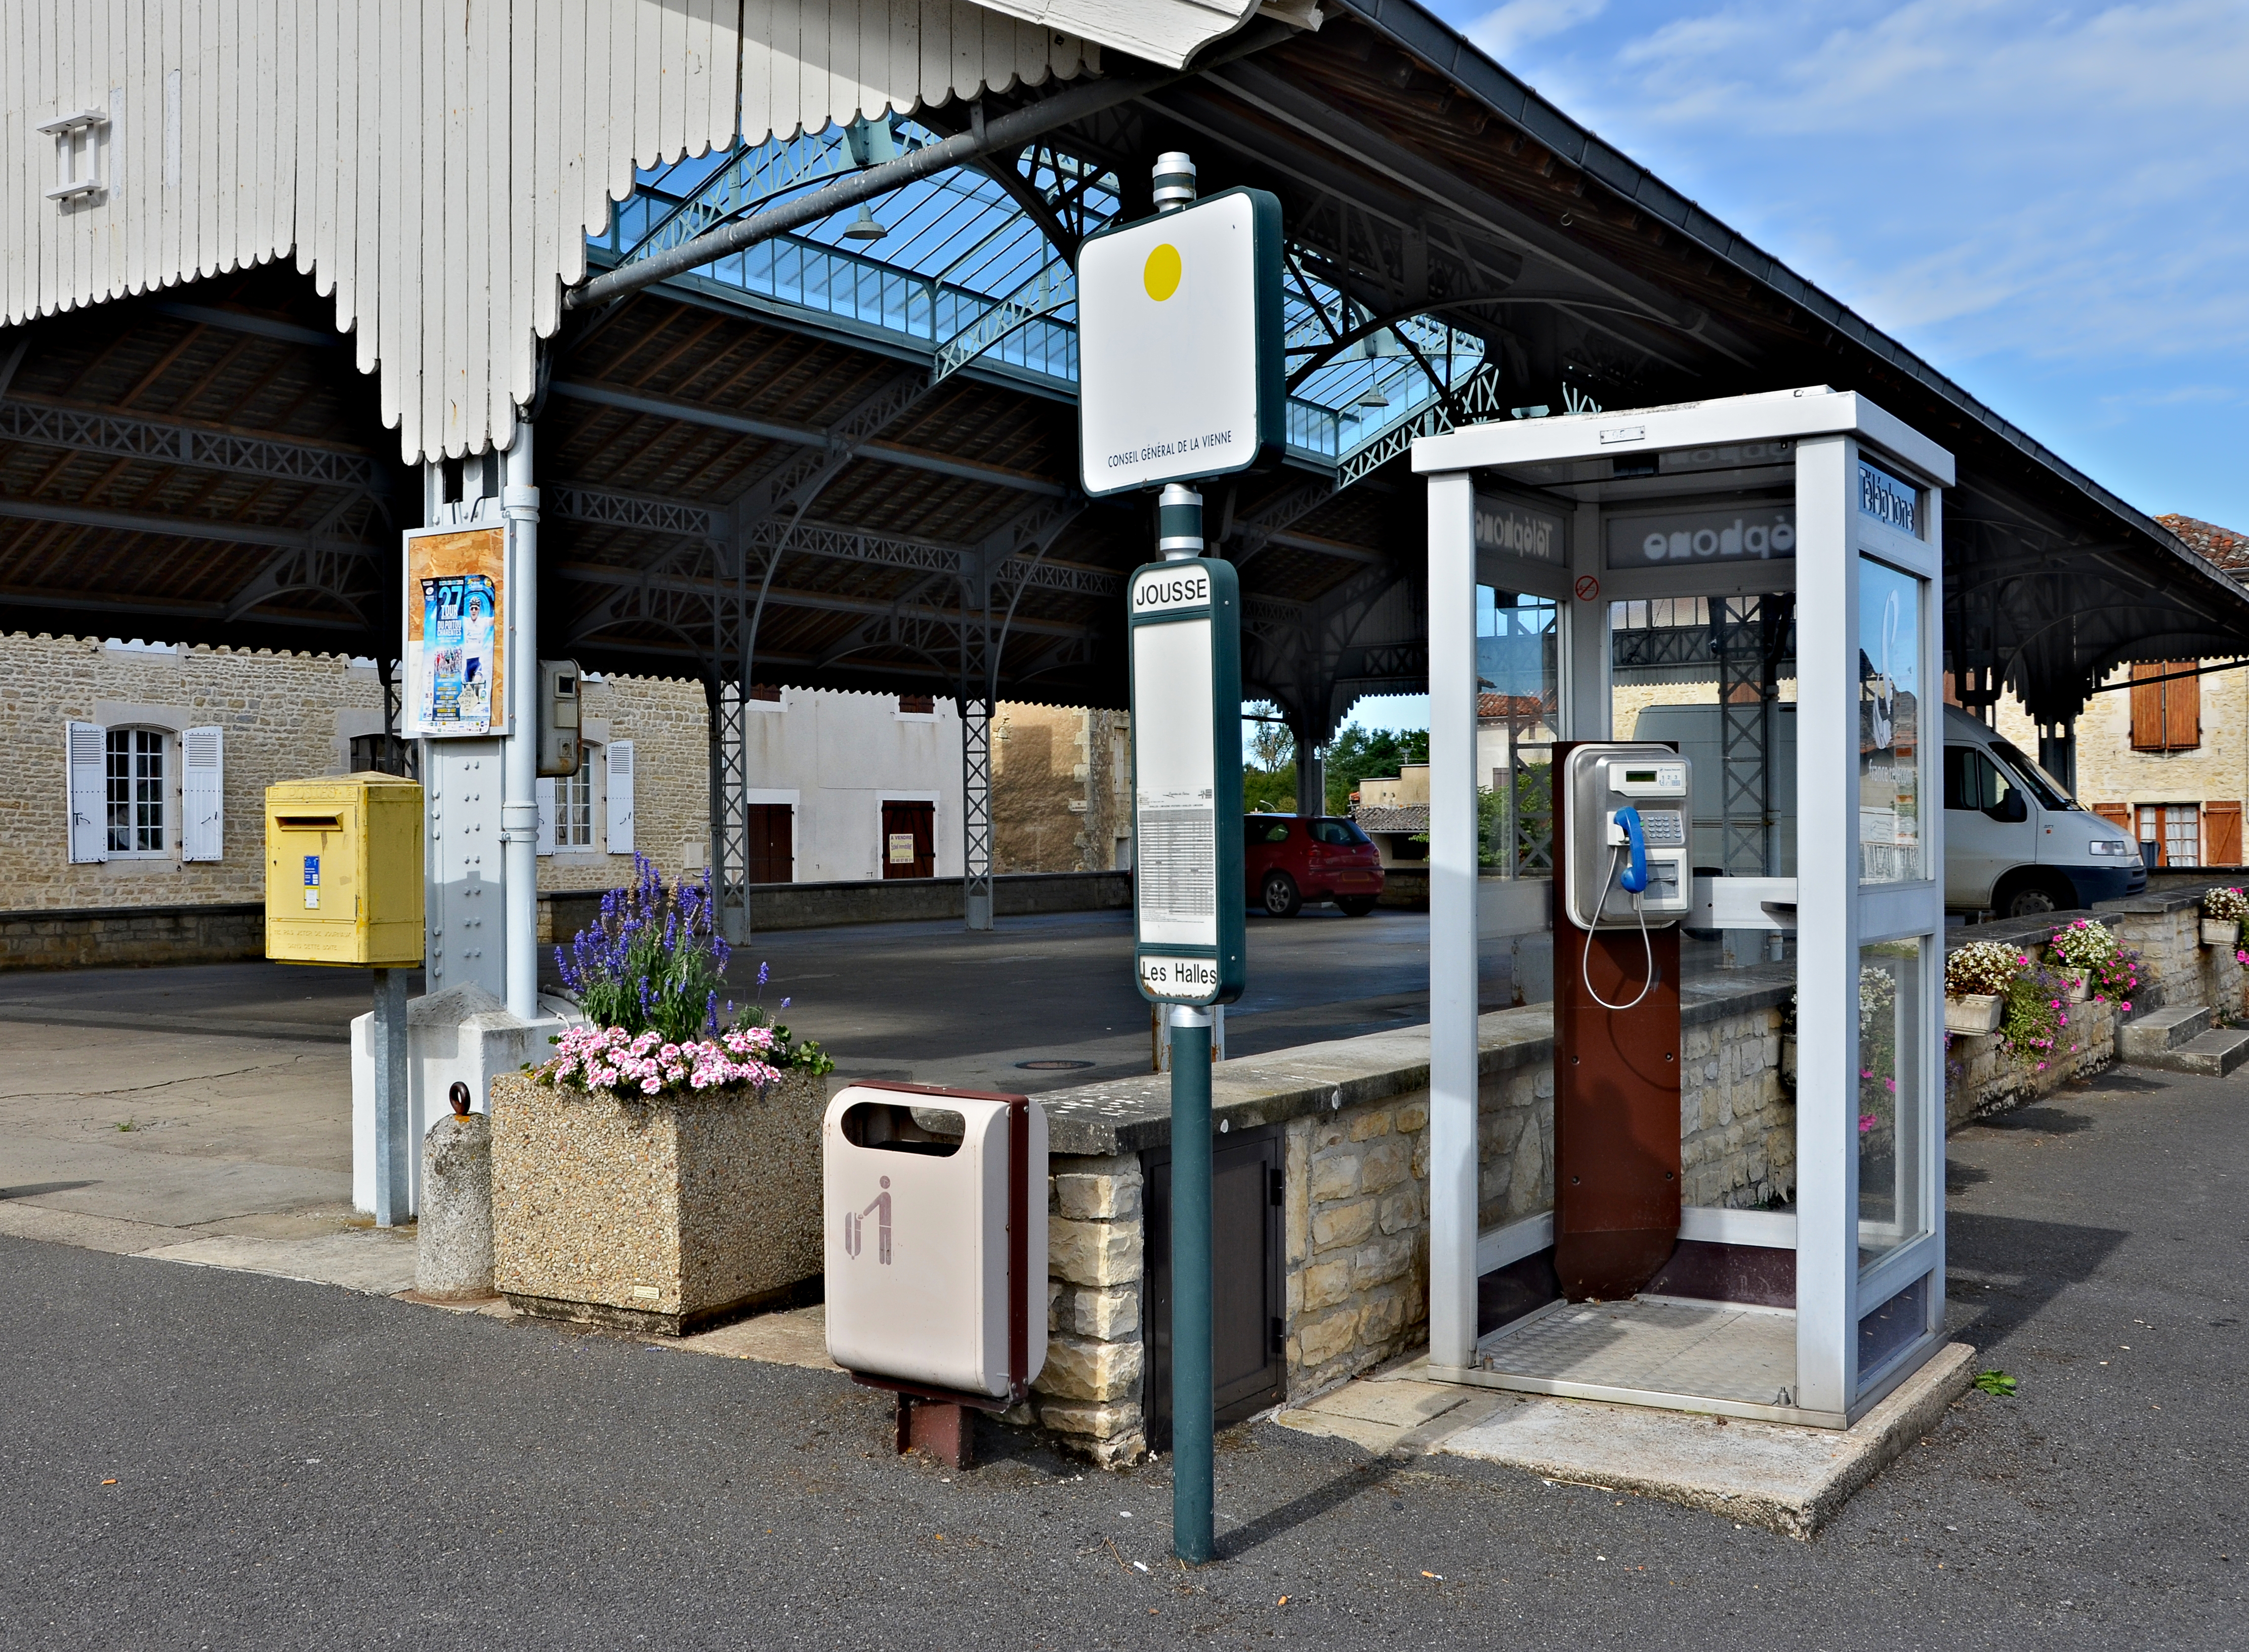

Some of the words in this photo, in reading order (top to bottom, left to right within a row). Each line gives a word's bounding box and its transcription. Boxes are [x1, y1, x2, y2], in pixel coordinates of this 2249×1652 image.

[1108, 451, 1138, 468] CONSEIL
[1141, 442, 1174, 461] GÉNÉRAL
[1178, 440, 1187, 452] DE
[1190, 438, 1199, 450] LA
[1202, 431, 1232, 447] VIENNE
[1859, 467, 1914, 532] Téléphone
[438, 586, 463, 612] 27
[1136, 579, 1207, 606] JOUSSE
[441, 604, 458, 616] TOUR
[1142, 961, 1166, 982] Les
[1175, 963, 1217, 984] Halles
